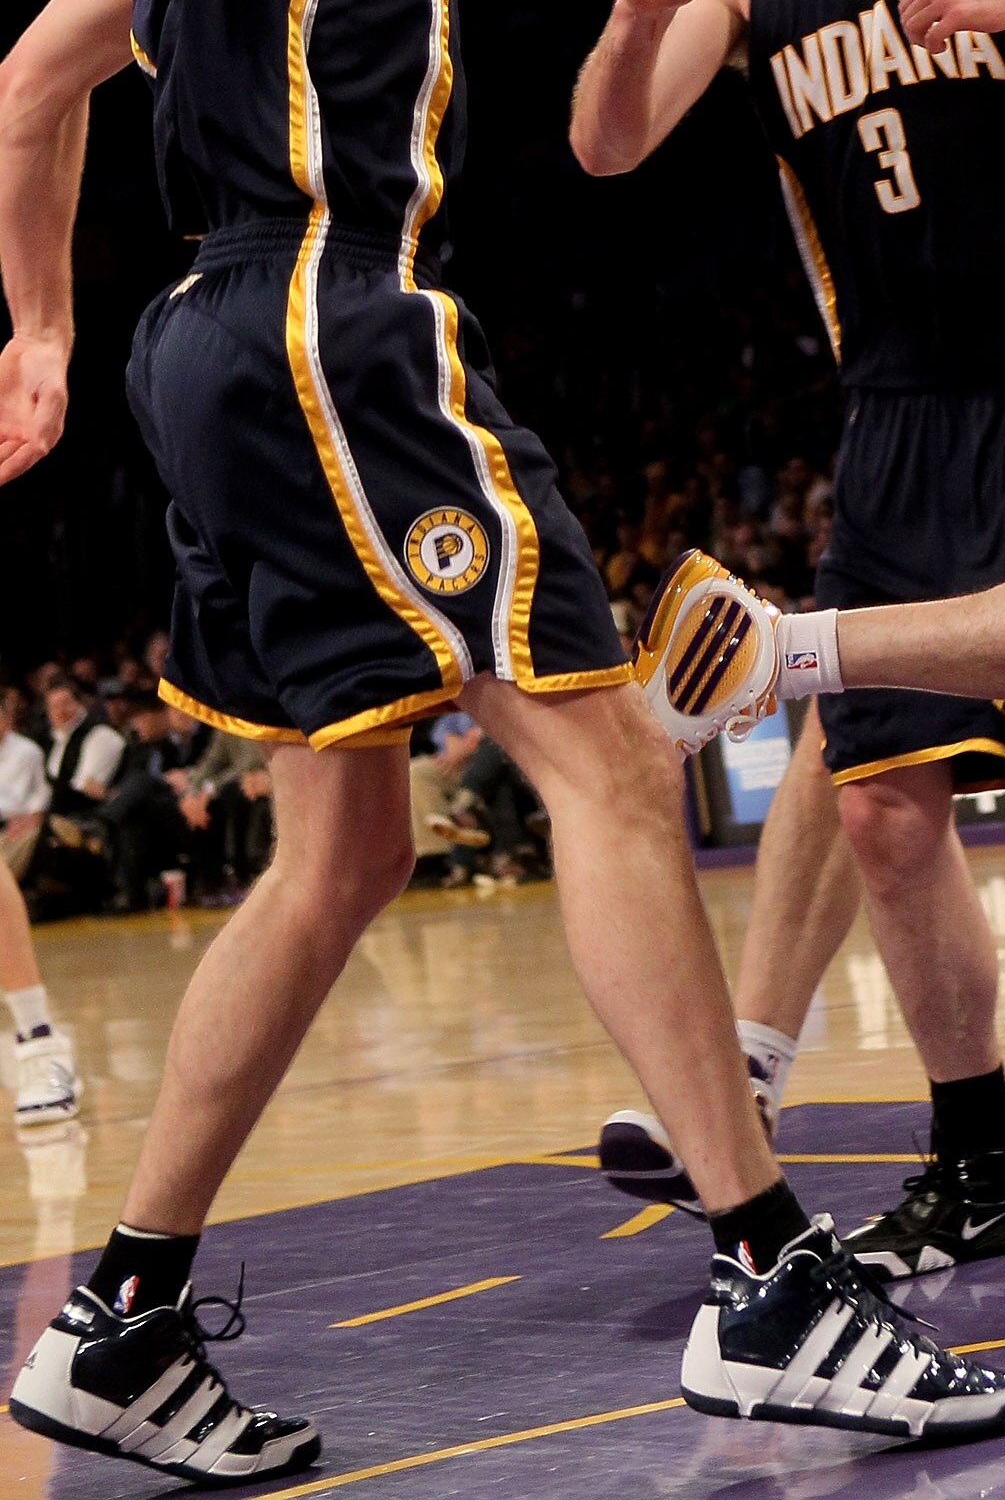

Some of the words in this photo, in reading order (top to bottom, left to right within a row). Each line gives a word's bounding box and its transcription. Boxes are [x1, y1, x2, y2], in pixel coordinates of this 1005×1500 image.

[857, 107, 921, 214] 3
[408, 511, 477, 559] INDIANA
[425, 553, 486, 592] PACERS
